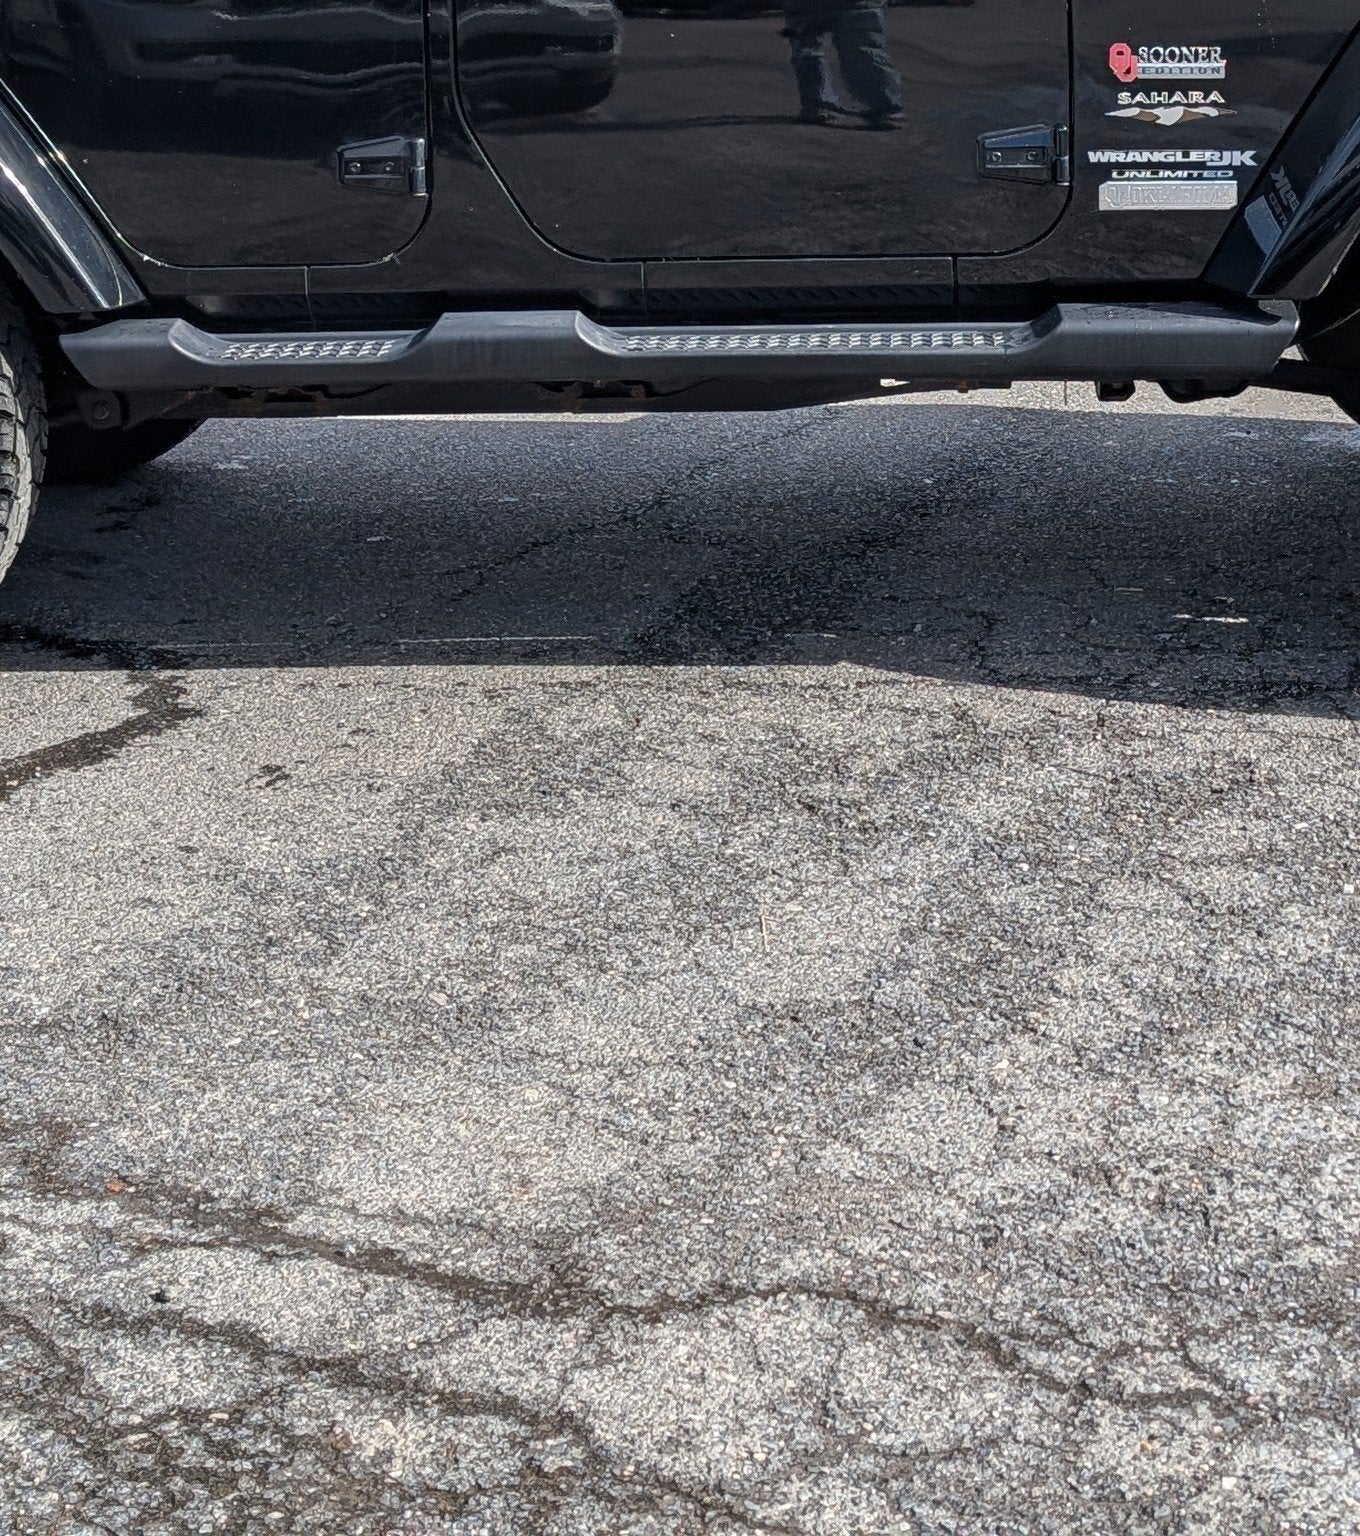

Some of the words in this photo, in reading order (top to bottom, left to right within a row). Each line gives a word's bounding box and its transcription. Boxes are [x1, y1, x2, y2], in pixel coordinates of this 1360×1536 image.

[1138, 46, 1223, 64] SOONER
[1140, 66, 1222, 75] EDITION
[1117, 91, 1225, 104] SAHARA
[1087, 150, 1220, 163] WRANGLER
[1206, 150, 1258, 166] JK
[1111, 170, 1234, 178] UNLIMITED
